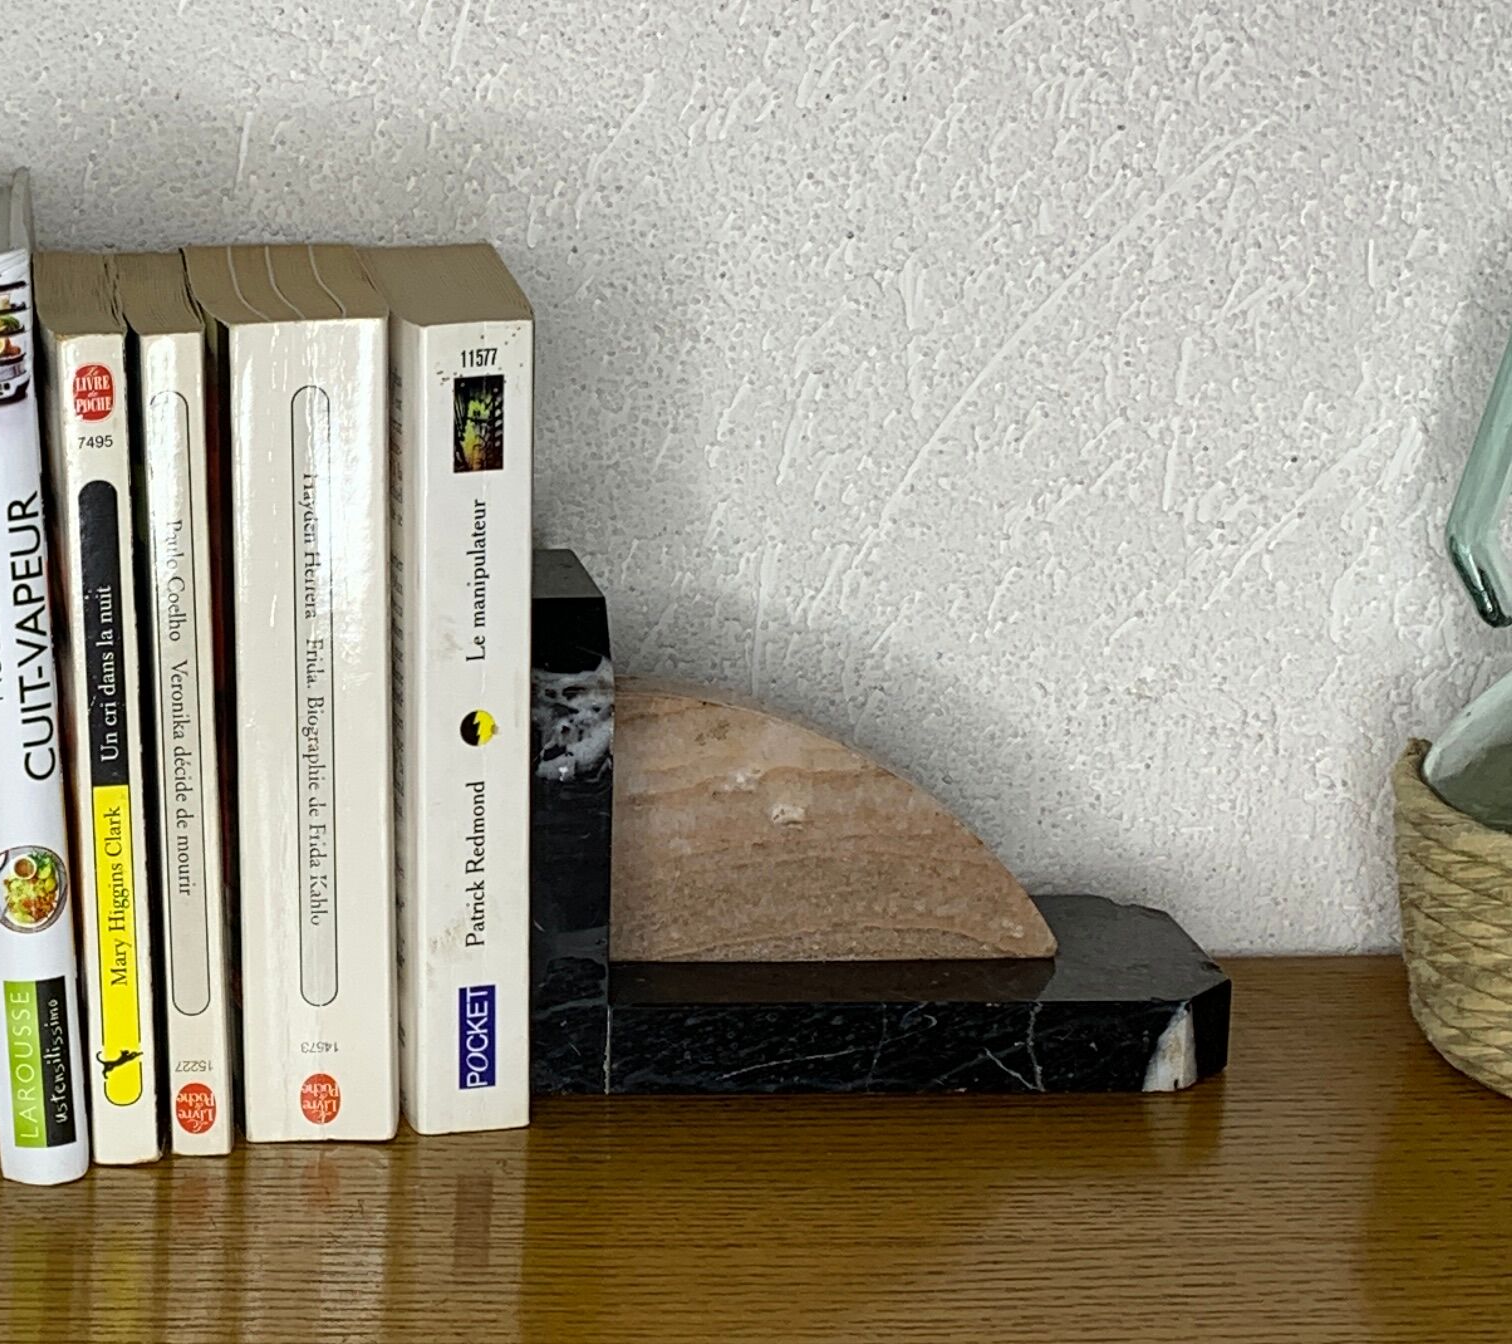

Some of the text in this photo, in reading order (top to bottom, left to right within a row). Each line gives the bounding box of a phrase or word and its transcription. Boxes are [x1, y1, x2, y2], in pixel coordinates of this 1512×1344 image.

[76, 375, 110, 391] LIVRE
[460, 348, 497, 368] 11577
[76, 396, 112, 413] POCHE
[78, 435, 113, 449] 7495
[465, 499, 490, 662] Le manipulateur
[168, 576, 186, 642] Coelho
[8, 491, 56, 781] CUIT-VAPEUR
[94, 585, 118, 762] Un cri dans la nuit
[306, 639, 324, 688] Frida.
[170, 660, 191, 739] Veronika
[302, 696, 325, 790] Biographie
[174, 747, 192, 803] décide
[176, 808, 193, 829] de
[309, 797, 326, 817] de
[177, 835, 195, 896] mourir
[309, 824, 327, 869] Frida
[466, 780, 485, 947] Patrick Redmond
[104, 806, 133, 987] Mary Higgins Clark
[310, 875, 328, 926] Kahlo
[42, 997, 68, 1123] ustensilissimo
[301, 1041, 339, 1054] 14573
[466, 986, 488, 1087] POCKET
[9, 991, 37, 1139] LAROUSSE
[175, 1061, 213, 1072] 15227
[177, 1092, 215, 1106] Poche
[178, 1108, 213, 1121] Livre
